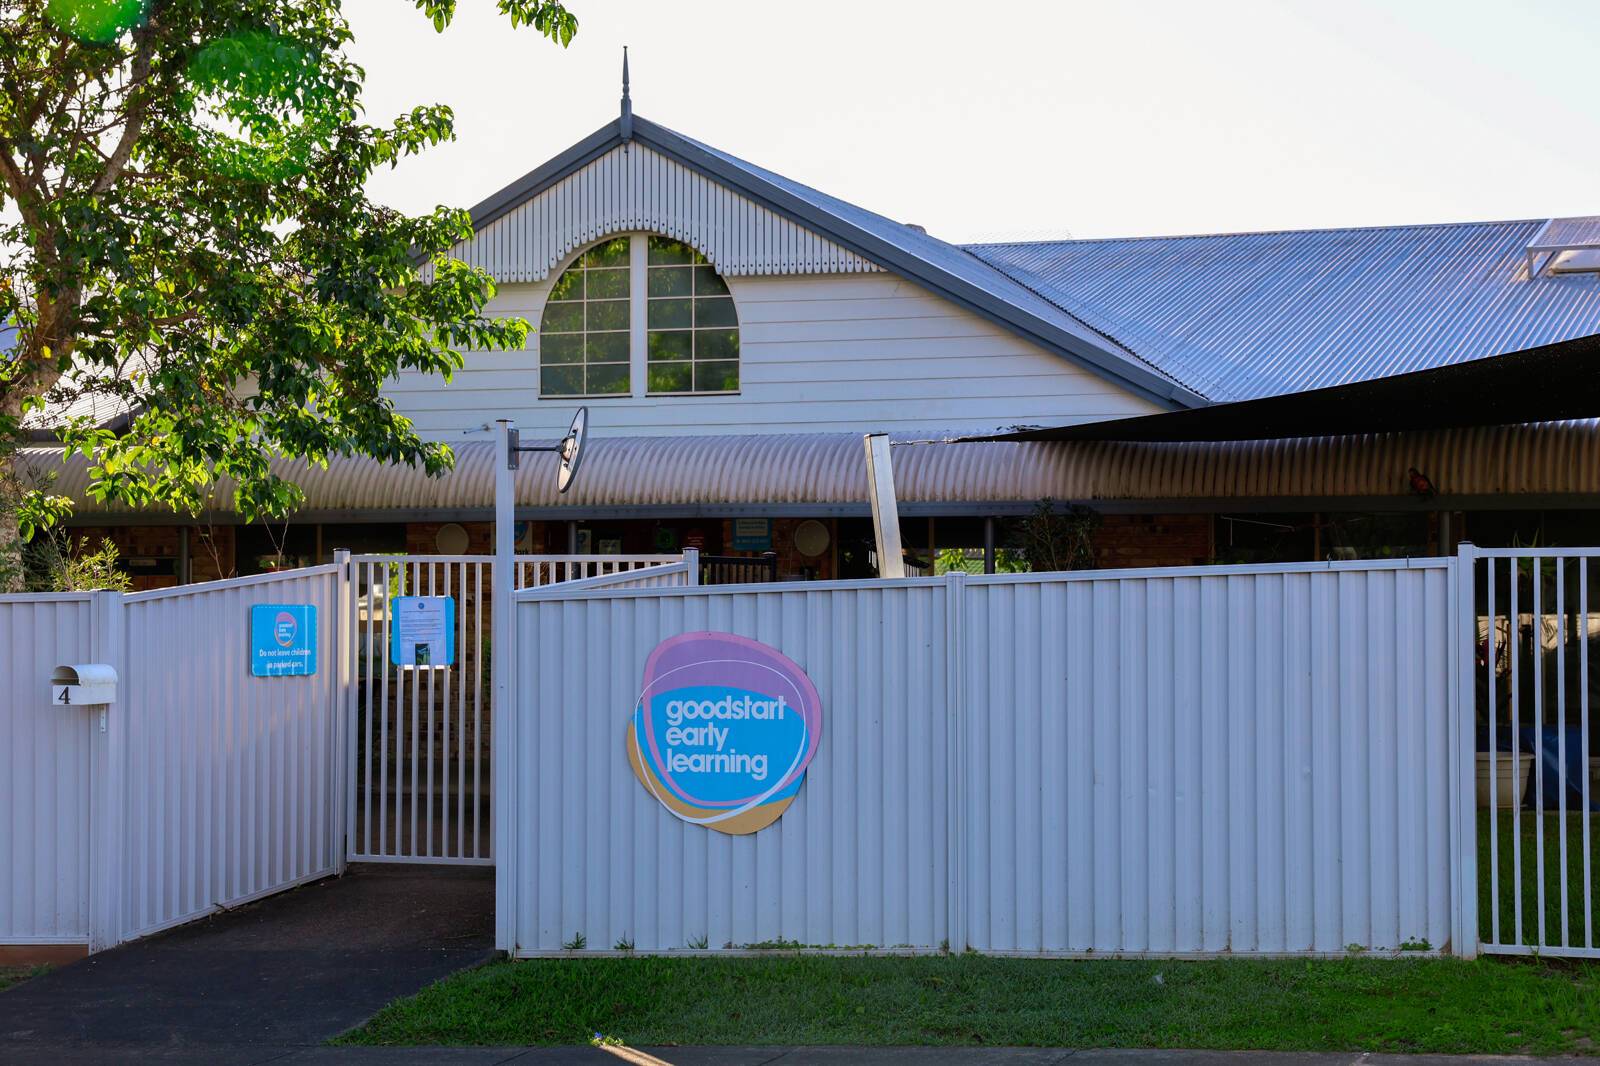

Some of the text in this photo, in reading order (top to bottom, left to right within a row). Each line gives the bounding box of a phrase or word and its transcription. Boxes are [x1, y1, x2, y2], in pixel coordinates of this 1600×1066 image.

[259, 647, 311, 657] Do not leave children
[58, 686, 71, 705] 4
[665, 695, 787, 726] goodstart
[665, 722, 729, 752] early
[666, 748, 768, 780] learning
